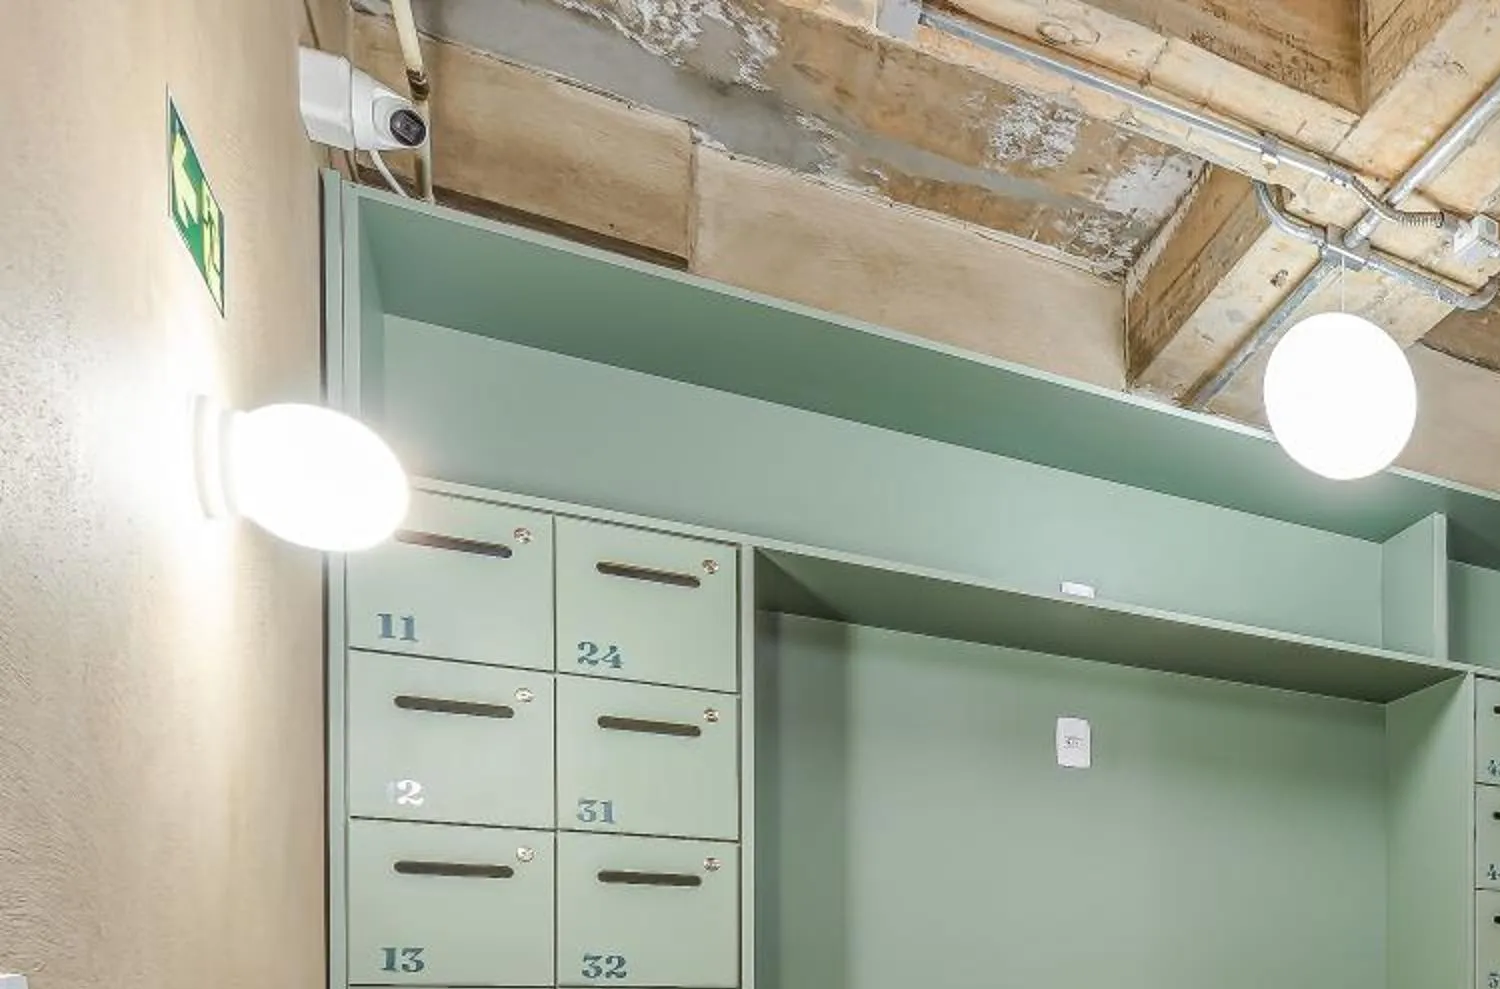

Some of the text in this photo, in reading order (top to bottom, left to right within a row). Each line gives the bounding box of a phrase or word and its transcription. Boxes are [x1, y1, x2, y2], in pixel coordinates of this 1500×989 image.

[378, 613, 419, 643] 11
[576, 641, 622, 669] 24
[576, 799, 616, 825] 31
[380, 947, 425, 973] 13
[581, 955, 628, 979] 32
